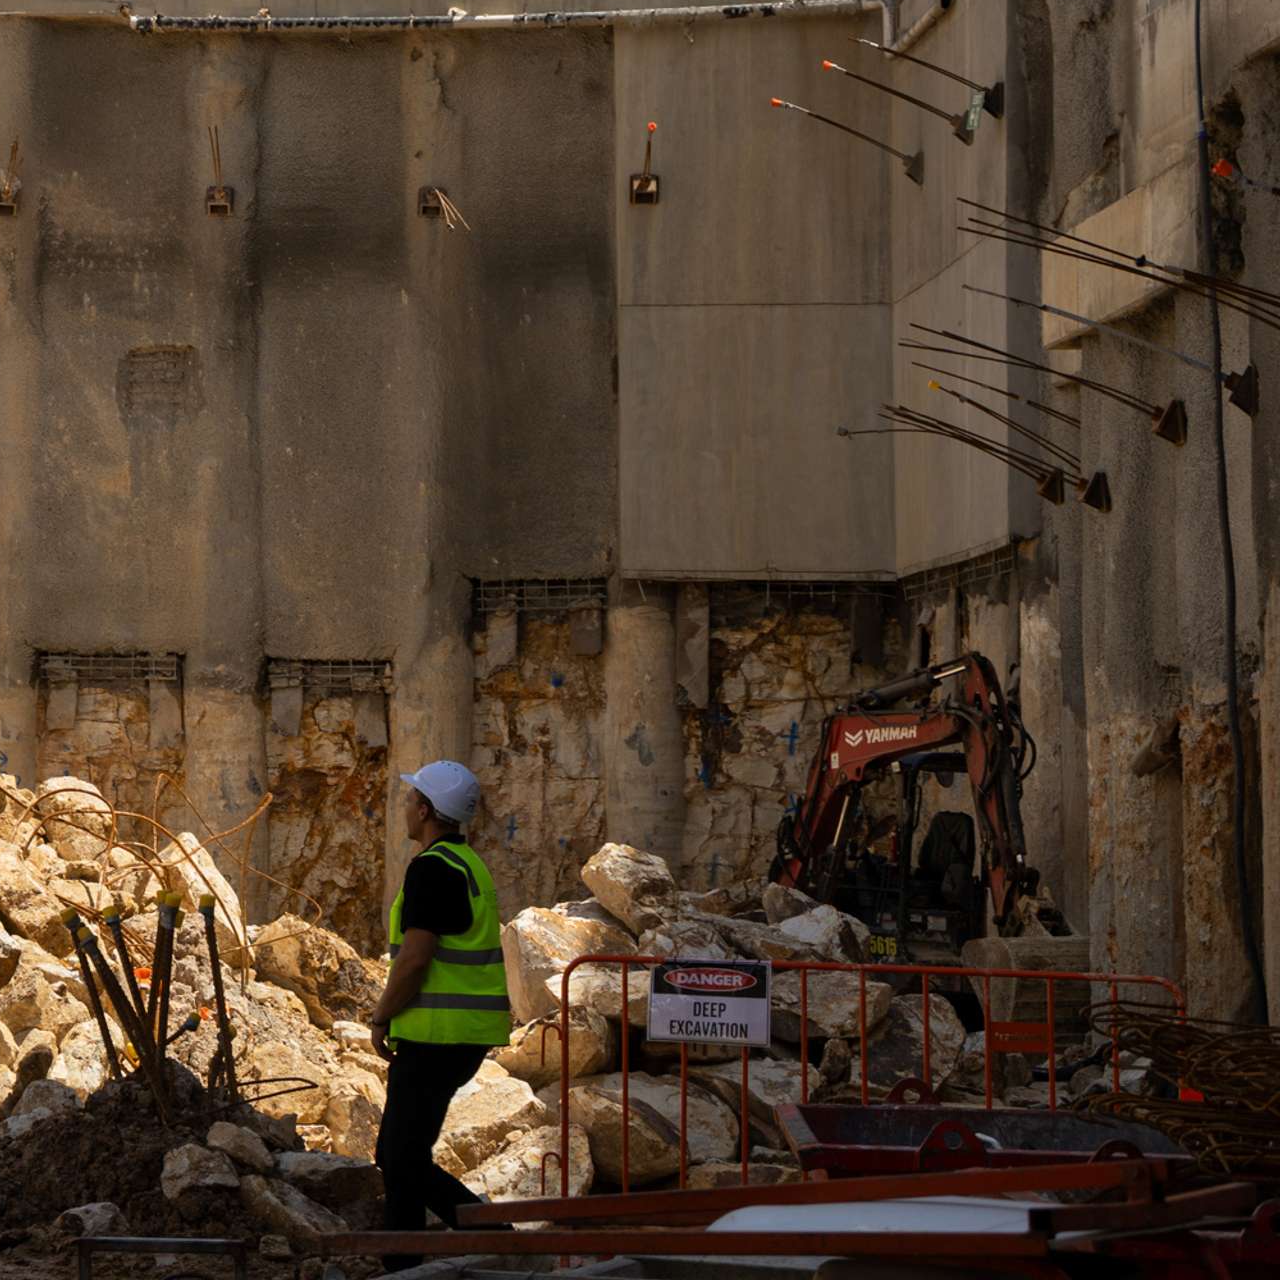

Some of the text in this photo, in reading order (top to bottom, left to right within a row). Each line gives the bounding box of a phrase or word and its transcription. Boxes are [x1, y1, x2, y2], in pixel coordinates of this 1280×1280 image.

[676, 972, 744, 987] DANGER
[693, 1001, 727, 1018] DEEP
[669, 1019, 749, 1039] EXCAVATION
